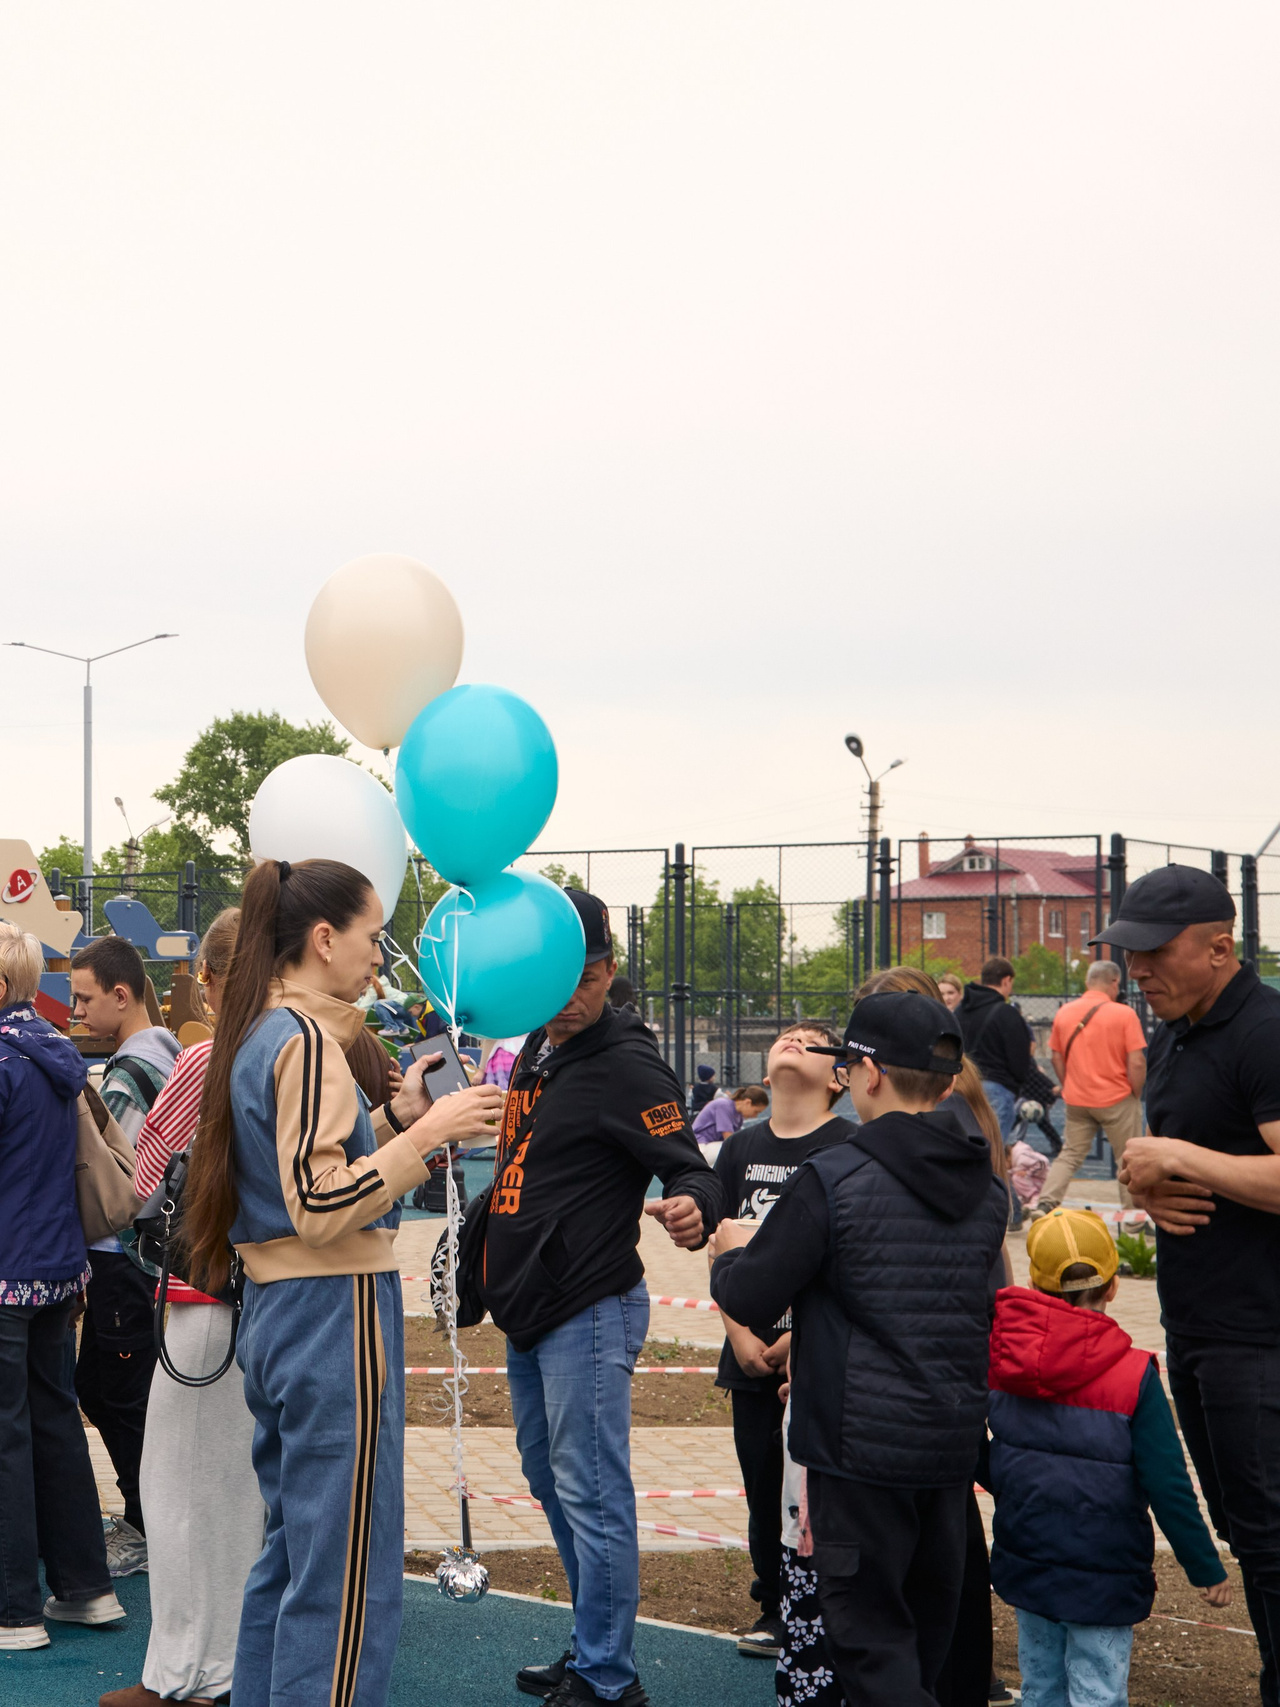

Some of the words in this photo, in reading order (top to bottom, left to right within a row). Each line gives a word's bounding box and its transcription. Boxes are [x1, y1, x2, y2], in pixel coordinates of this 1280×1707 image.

[645, 1104, 678, 1126] 1980
[649, 1124, 672, 1137] Super
[745, 1164, 798, 1184] СЛАВЯНС
